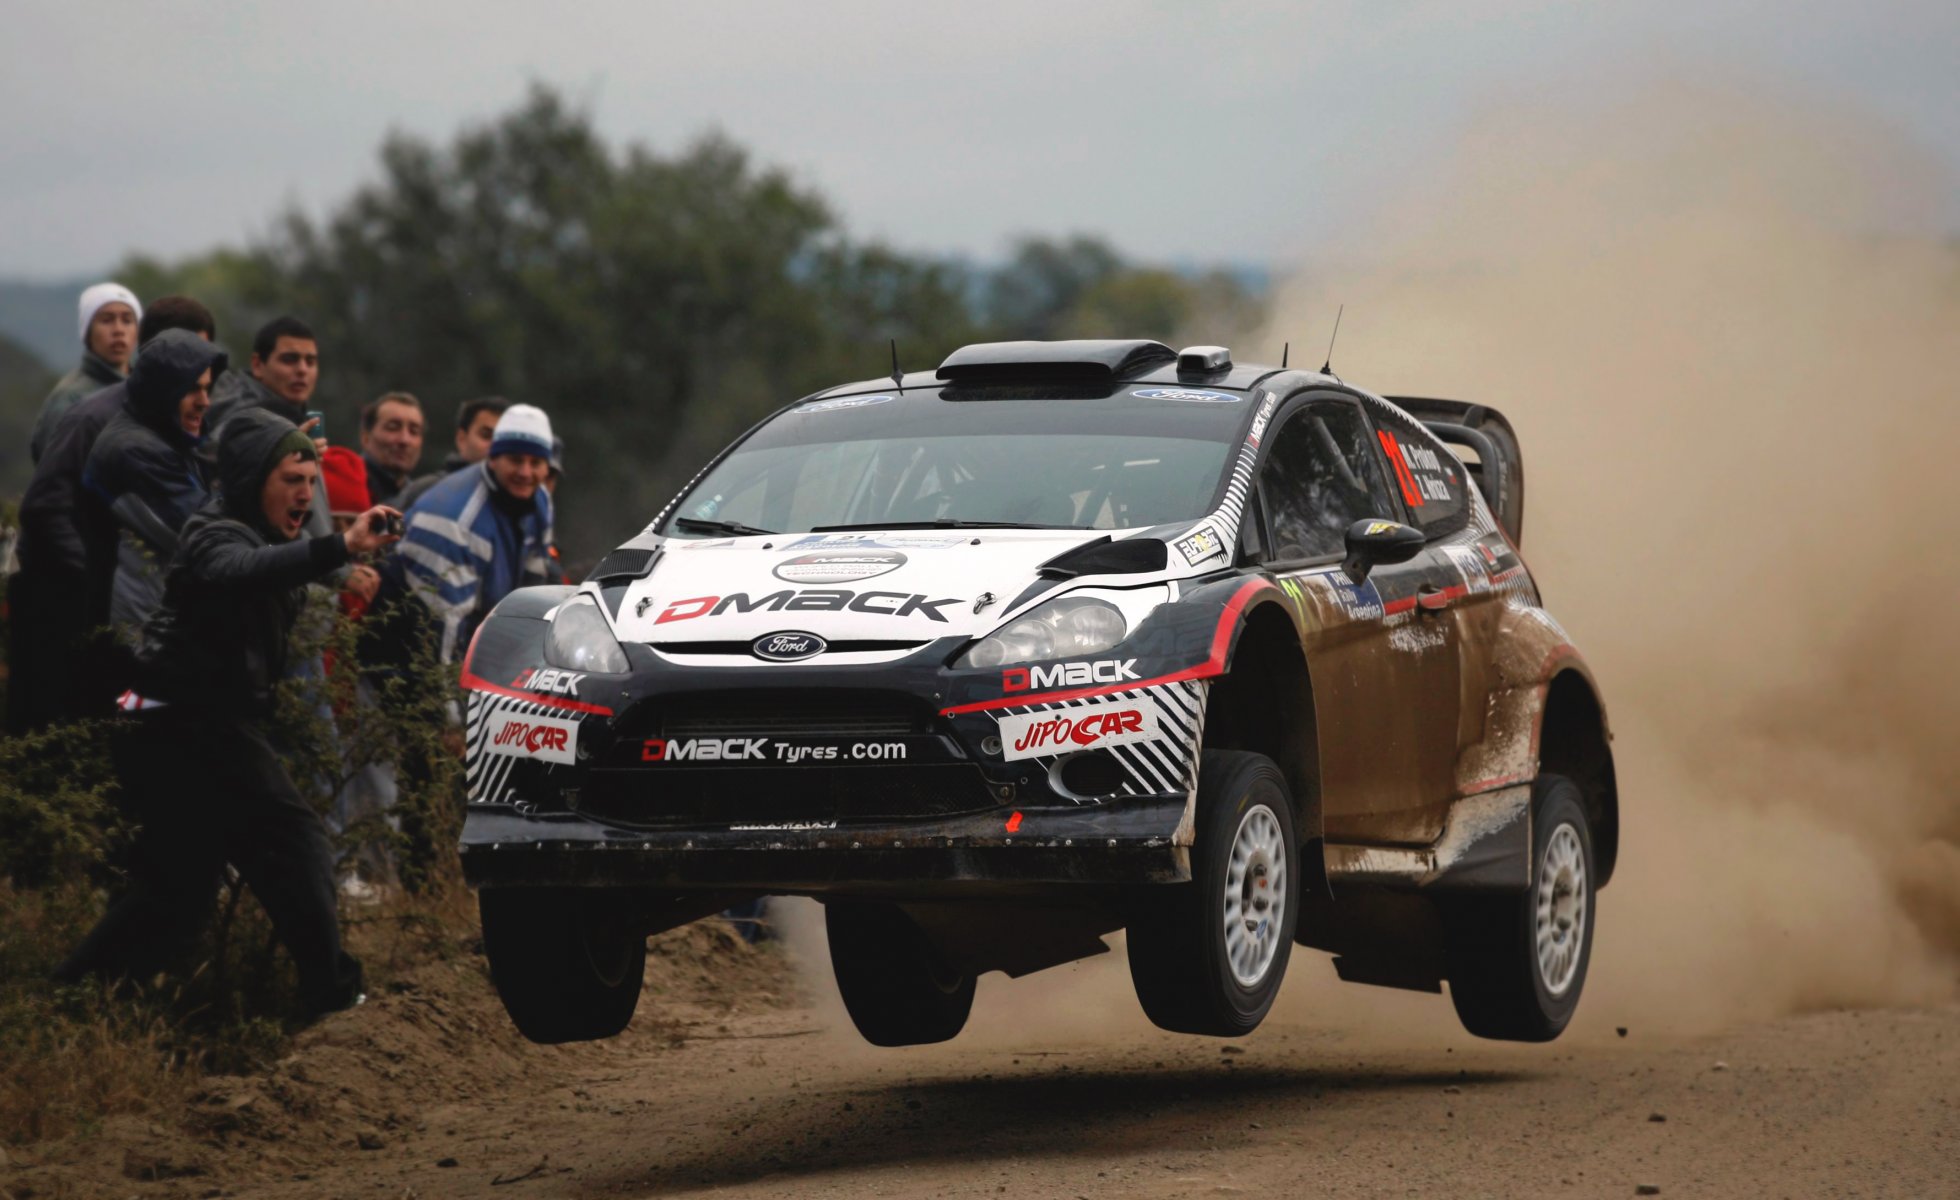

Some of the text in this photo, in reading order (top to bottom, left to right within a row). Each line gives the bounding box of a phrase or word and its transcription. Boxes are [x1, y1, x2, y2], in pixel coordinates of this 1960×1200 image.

[1151, 389, 1221, 401] Ford
[1377, 429, 1424, 507] 21
[793, 557, 896, 565] DMACK
[653, 589, 967, 624] DMACK
[768, 635, 809, 653] Ford
[510, 667, 588, 696] DMACK
[1002, 658, 1141, 692] DMACK
[641, 738, 907, 763] DMACK Tyres .com
